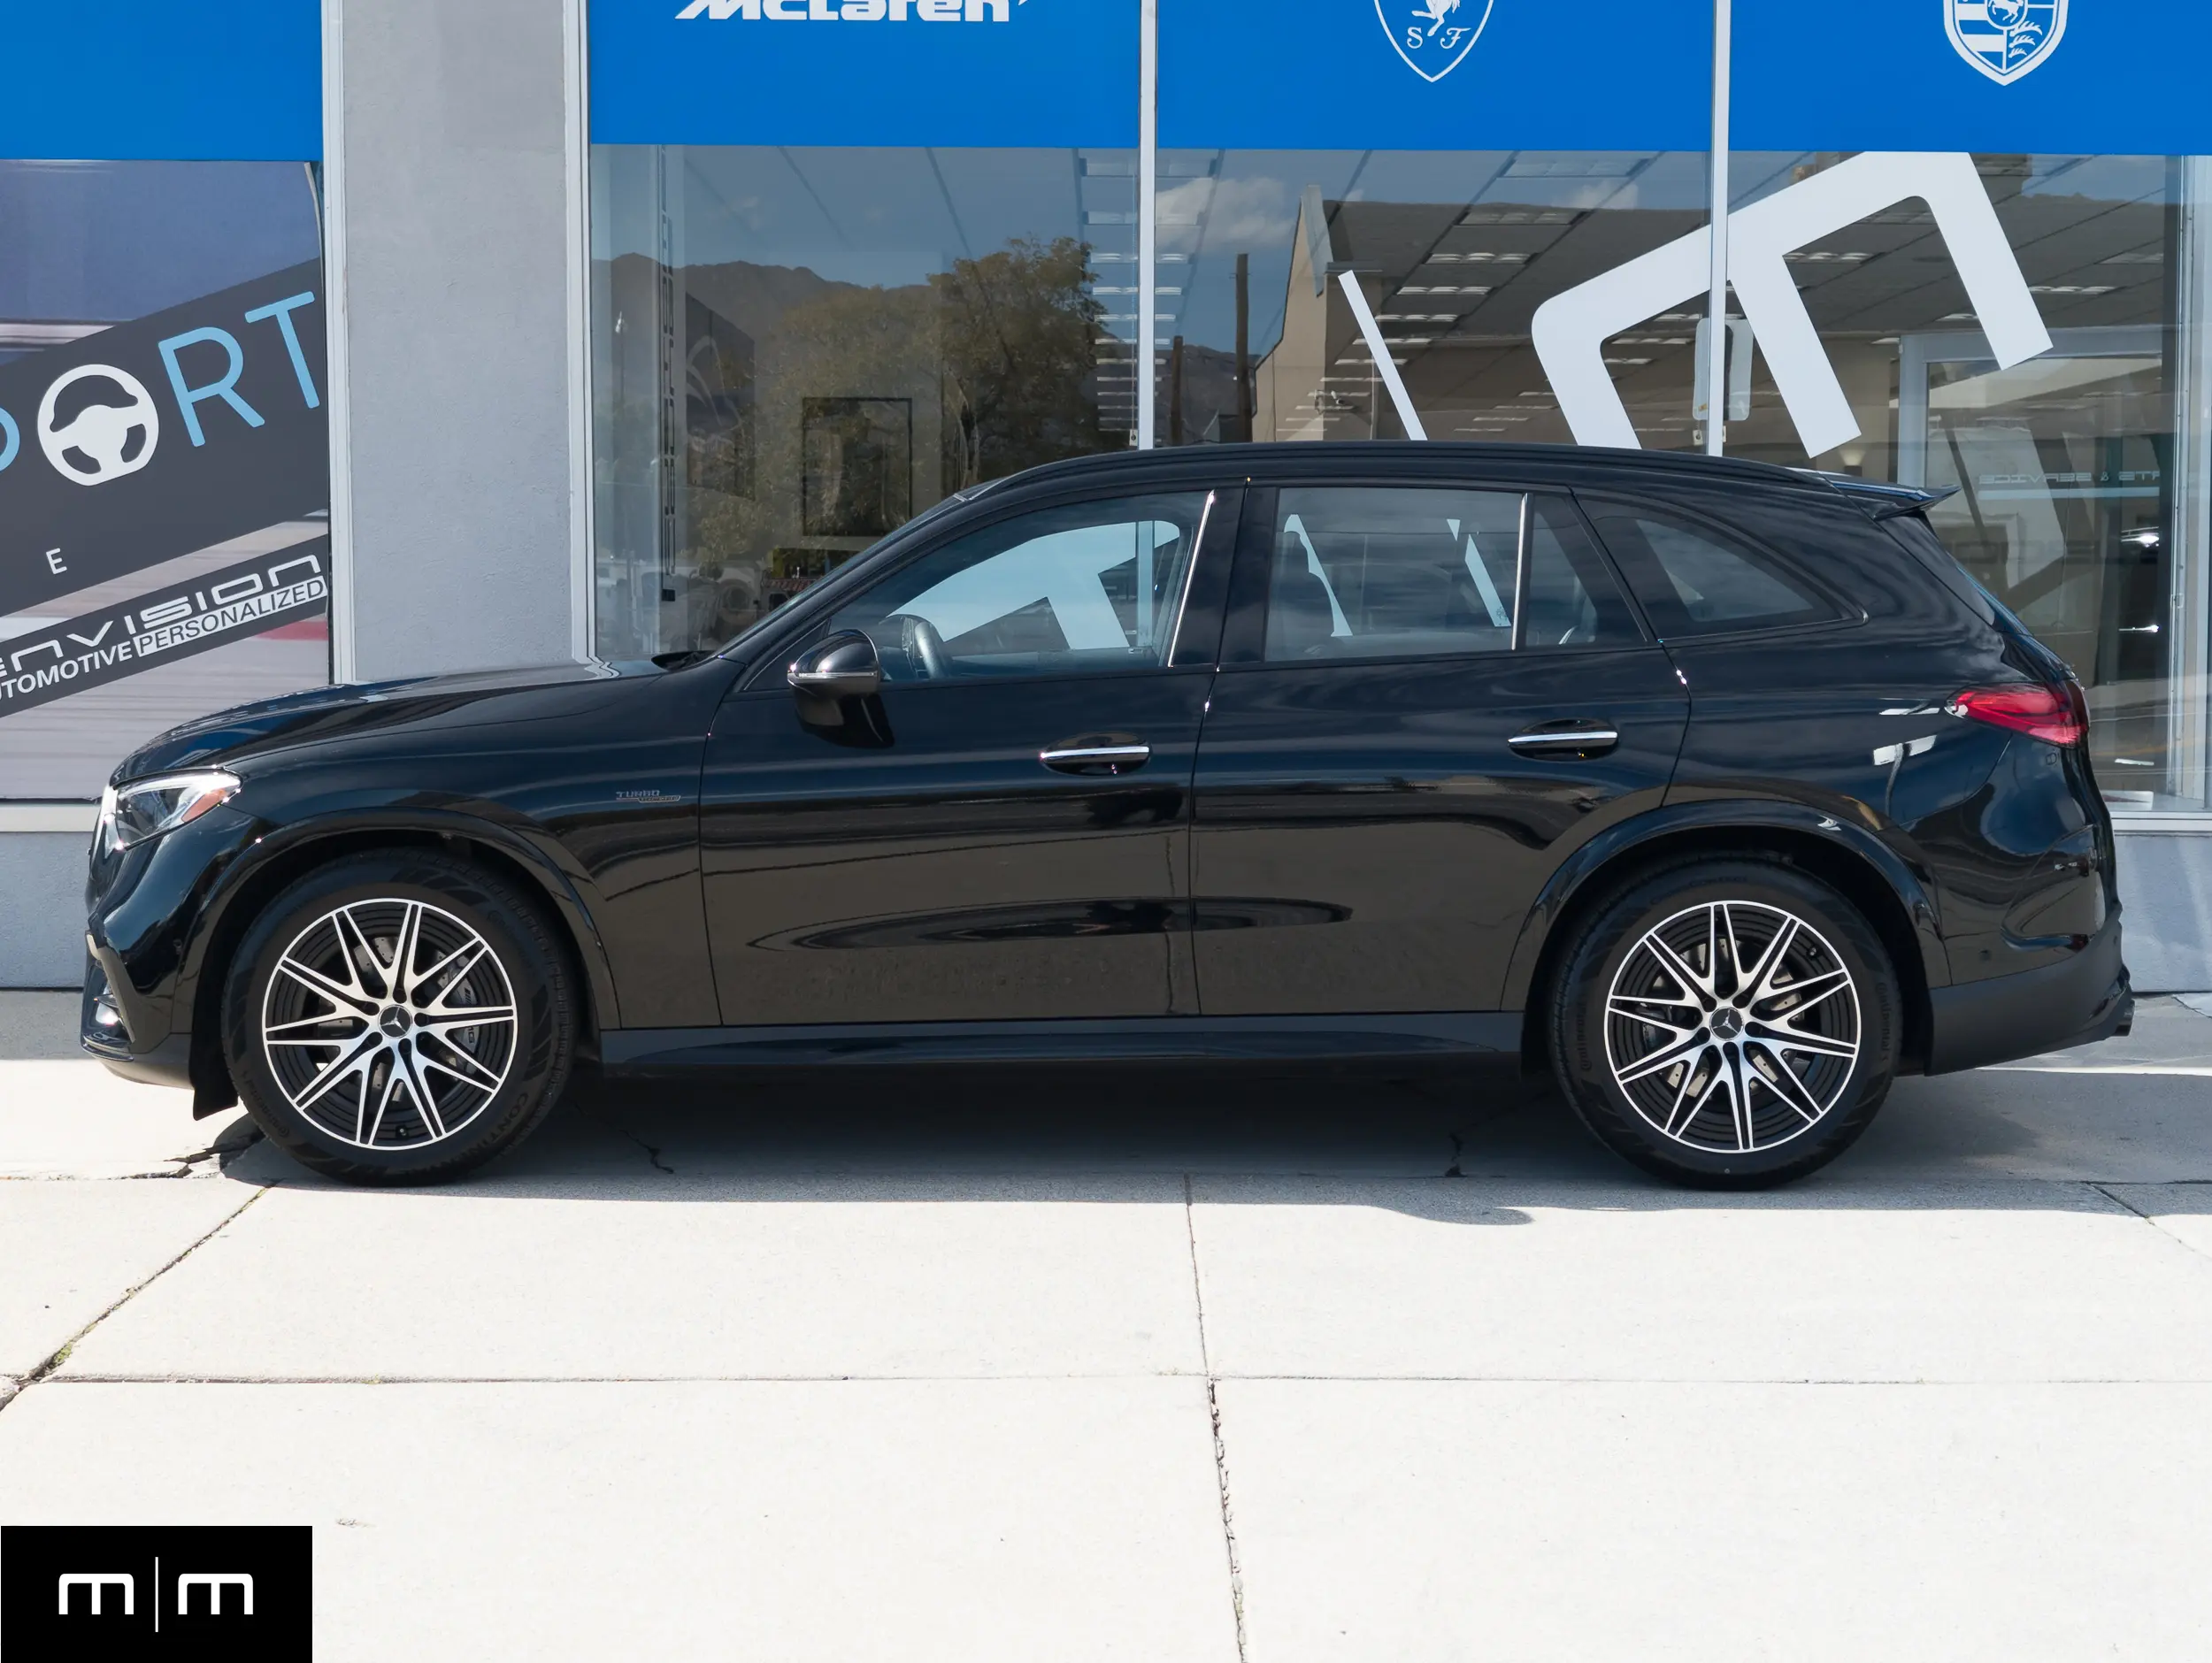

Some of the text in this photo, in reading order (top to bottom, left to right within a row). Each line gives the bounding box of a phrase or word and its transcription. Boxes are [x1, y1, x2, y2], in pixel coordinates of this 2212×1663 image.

[46, 548, 67, 575] E
[0, 579, 325, 700] TOMOTIVE PERSONALIZED
